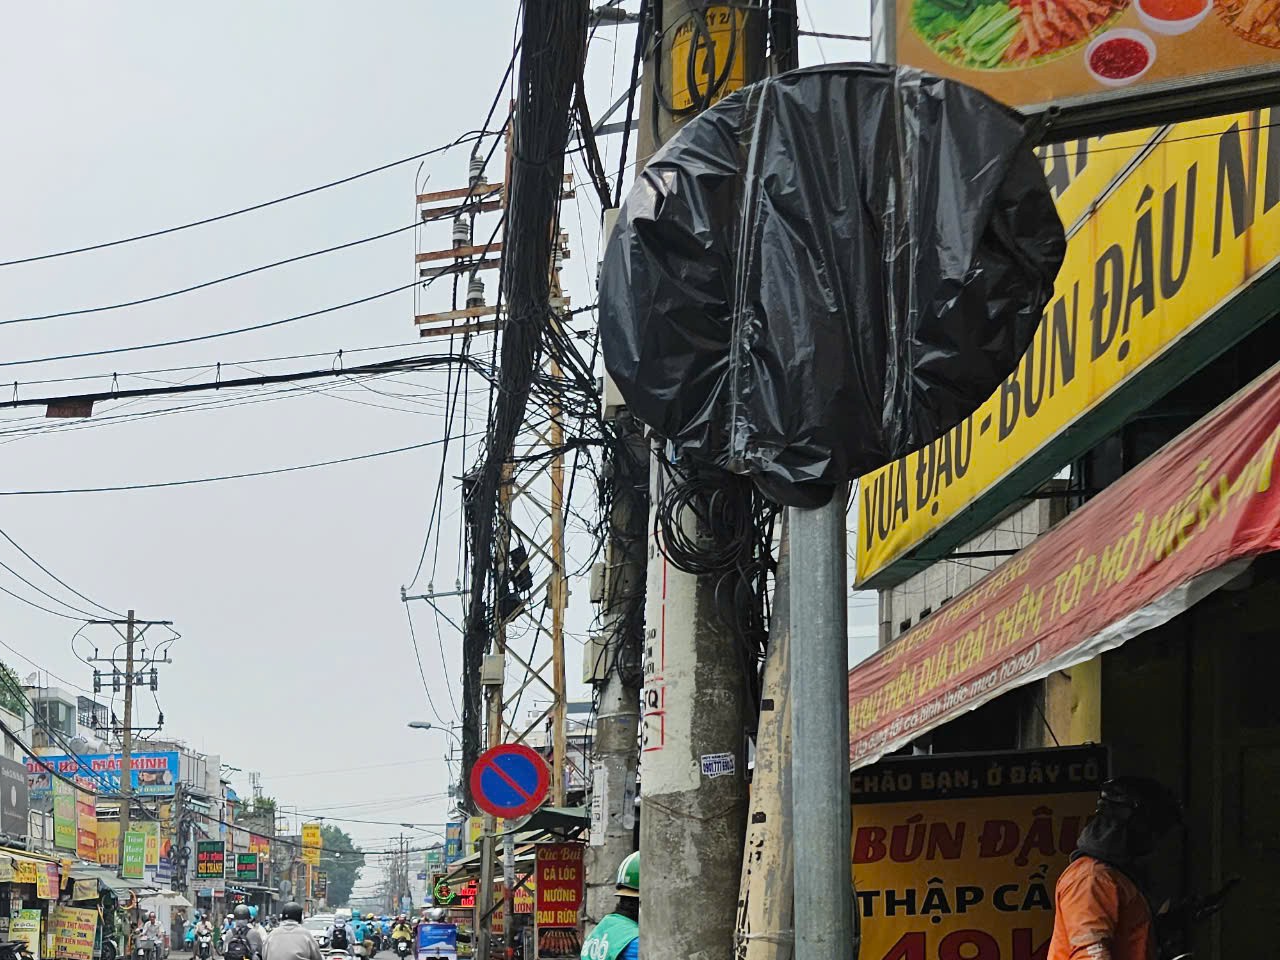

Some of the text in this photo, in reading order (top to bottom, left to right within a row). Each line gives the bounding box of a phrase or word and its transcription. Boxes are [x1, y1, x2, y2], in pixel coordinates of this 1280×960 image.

[864, 455, 909, 553] VUA
[130, 757, 168, 769] KÍNH
[851, 813, 968, 866] BÚN
[544, 886, 576, 902] NƯỚNG
[856, 863, 1054, 925] THẬP CẨ
